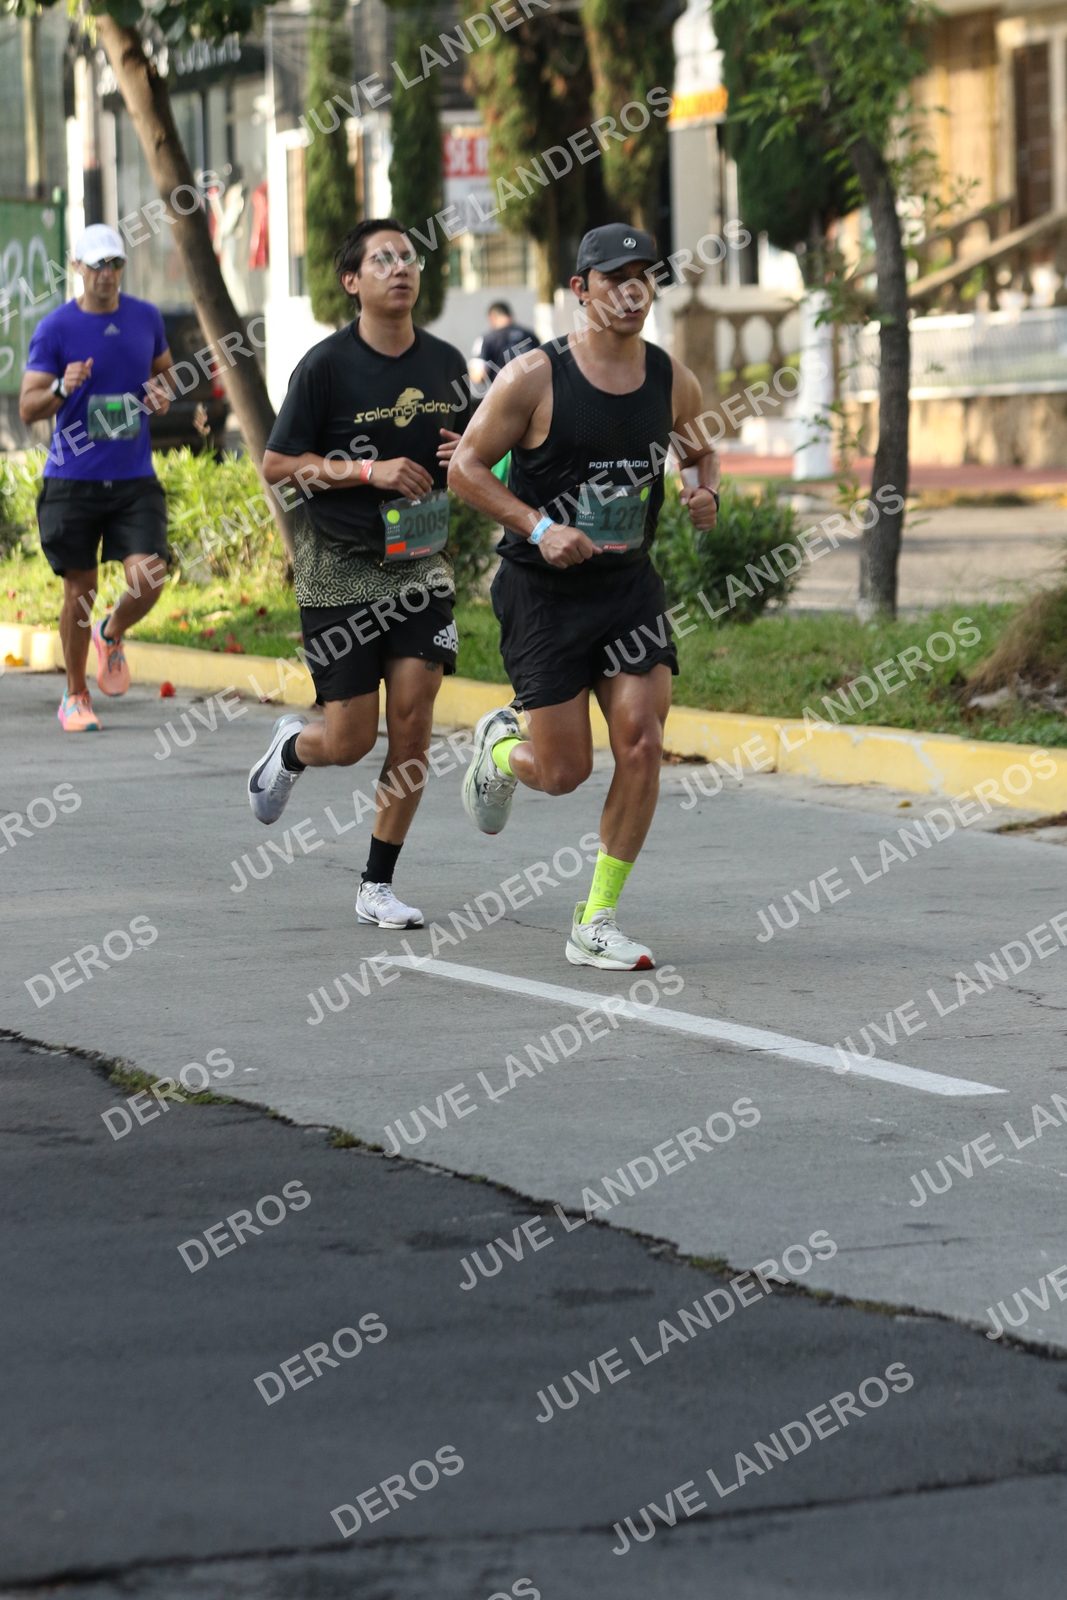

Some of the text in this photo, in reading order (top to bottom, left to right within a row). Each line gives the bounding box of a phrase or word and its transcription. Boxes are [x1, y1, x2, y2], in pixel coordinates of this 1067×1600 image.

[588, 460, 649, 469] PORT STUDIO
[403, 508, 447, 539] 2005
